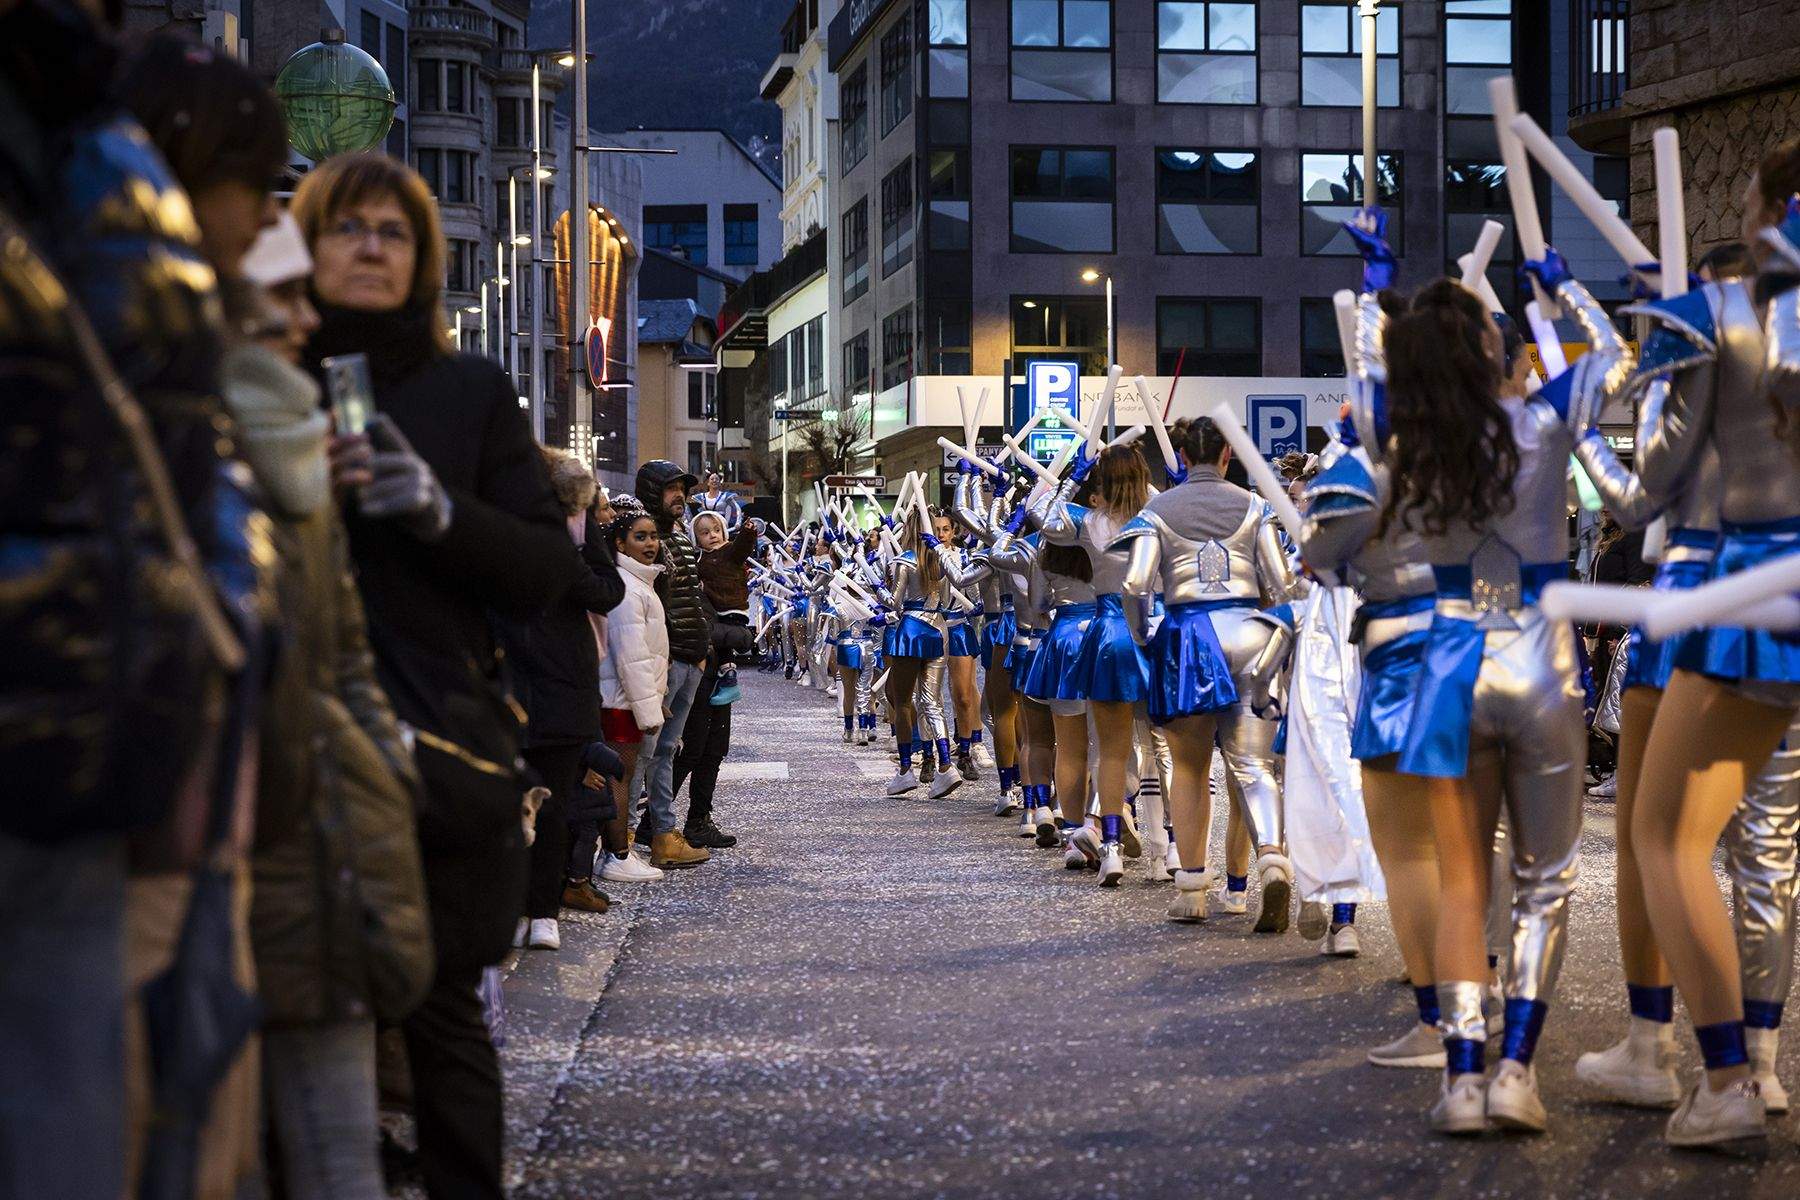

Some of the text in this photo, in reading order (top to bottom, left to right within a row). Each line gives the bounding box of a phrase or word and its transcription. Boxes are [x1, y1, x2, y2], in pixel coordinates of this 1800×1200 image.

[1036, 366, 1071, 407] P
[1259, 407, 1298, 454] P
[976, 447, 1003, 456] SPANY
